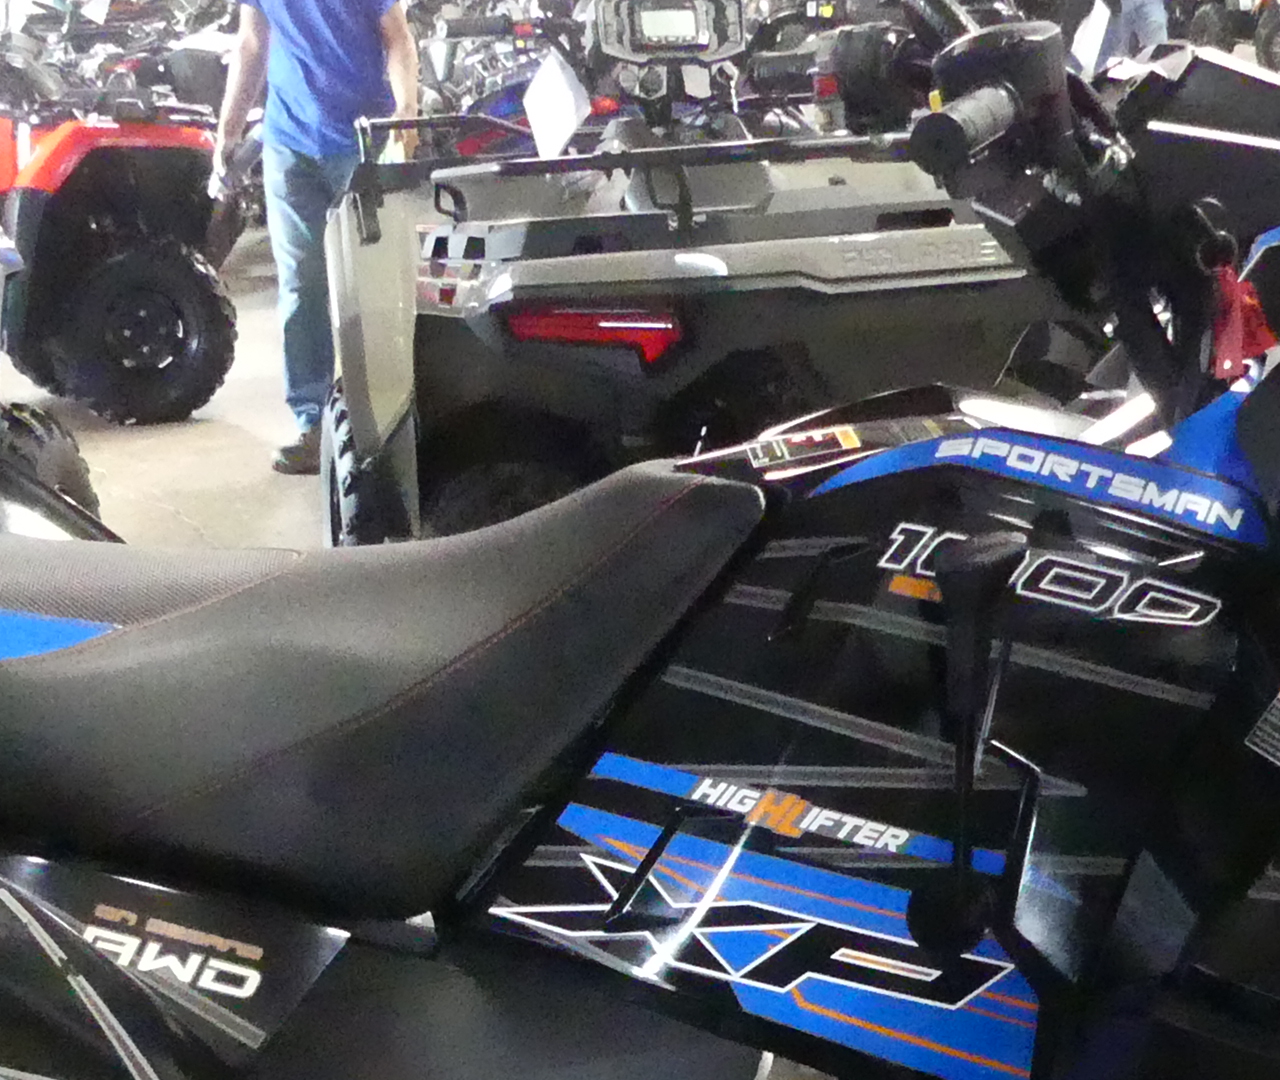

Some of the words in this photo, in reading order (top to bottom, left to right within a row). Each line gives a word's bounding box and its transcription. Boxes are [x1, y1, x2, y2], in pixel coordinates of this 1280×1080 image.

[935, 438, 1244, 531] SPORTSMAN
[82, 926, 262, 999] AWD
[488, 852, 1015, 1010] XP
